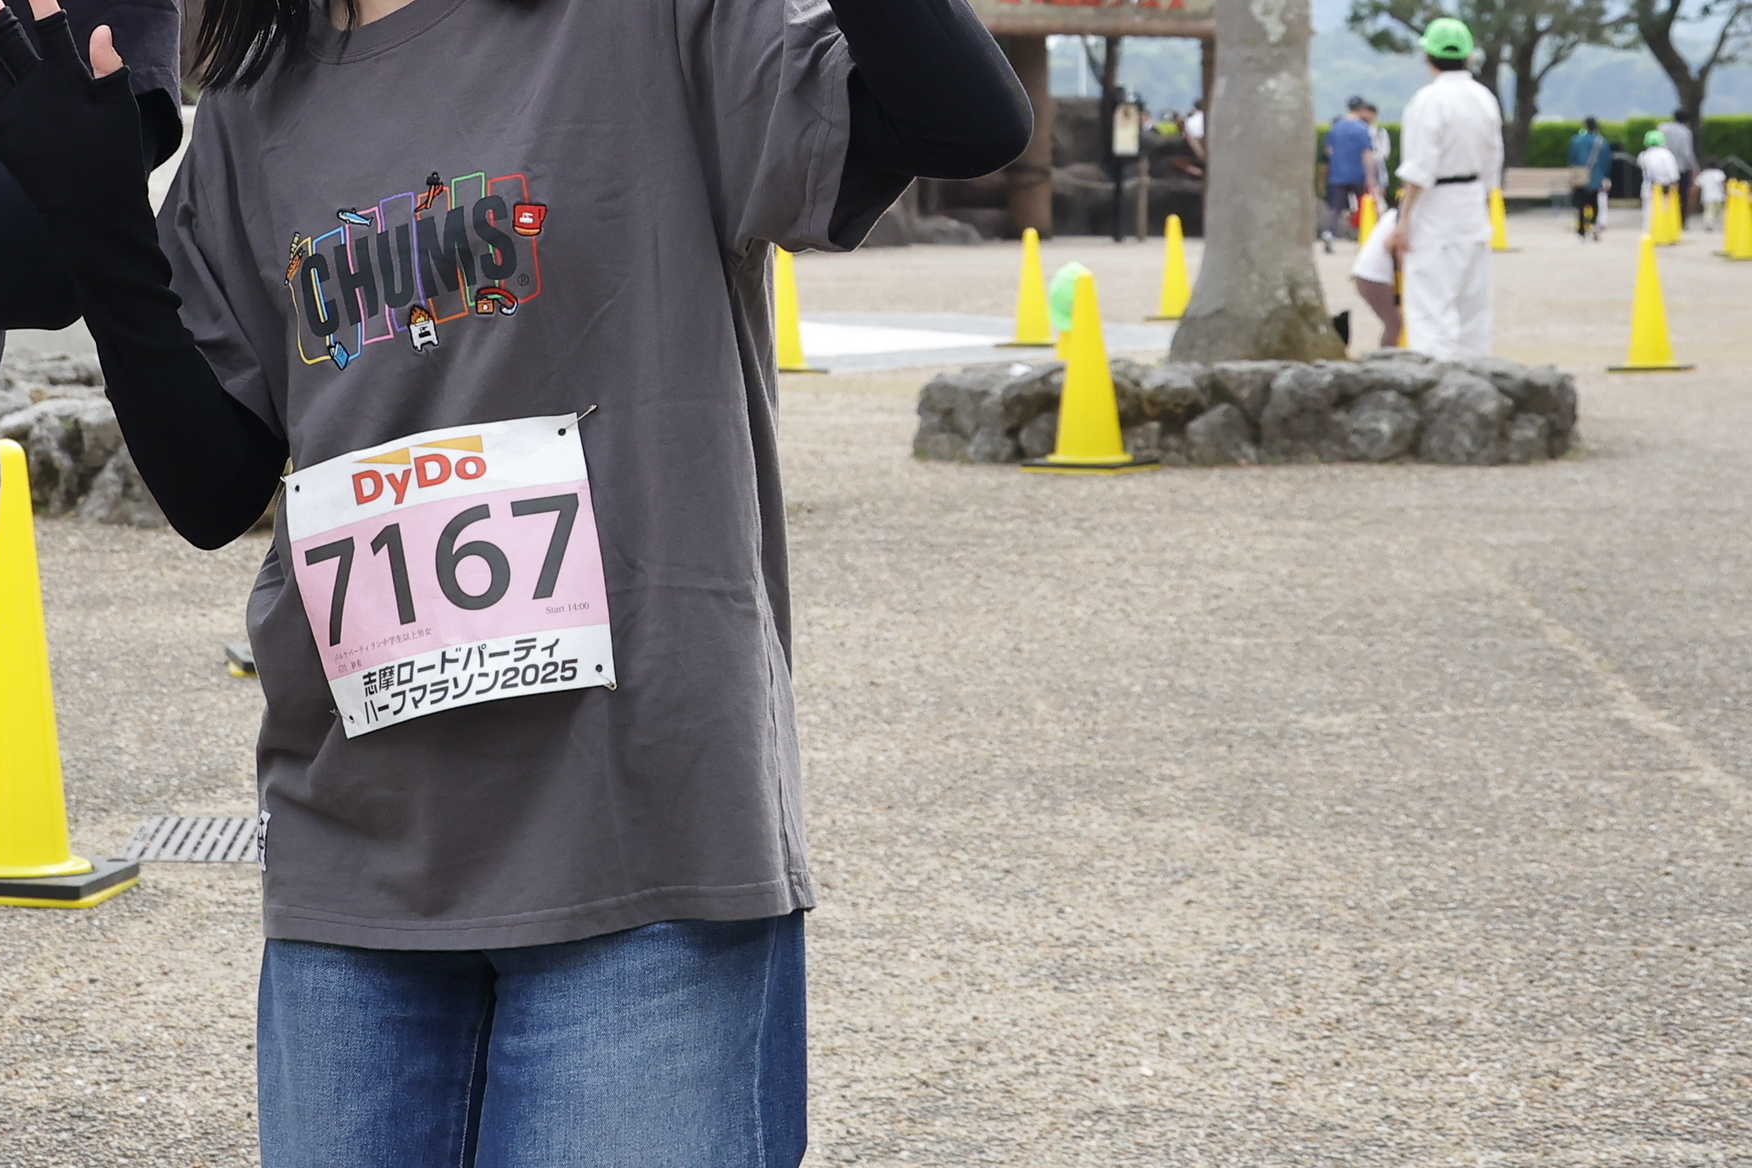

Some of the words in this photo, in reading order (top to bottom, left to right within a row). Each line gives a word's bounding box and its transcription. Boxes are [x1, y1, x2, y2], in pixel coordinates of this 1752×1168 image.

[300, 195, 517, 338] CHUMS
[351, 452, 487, 506] DyDo
[304, 493, 579, 647] 7167
[545, 604, 565, 615] Start
[567, 601, 590, 614] 14:00
[362, 637, 561, 697] 志摩ロードパーティ
[364, 658, 579, 724] ハーフマラソン2025
